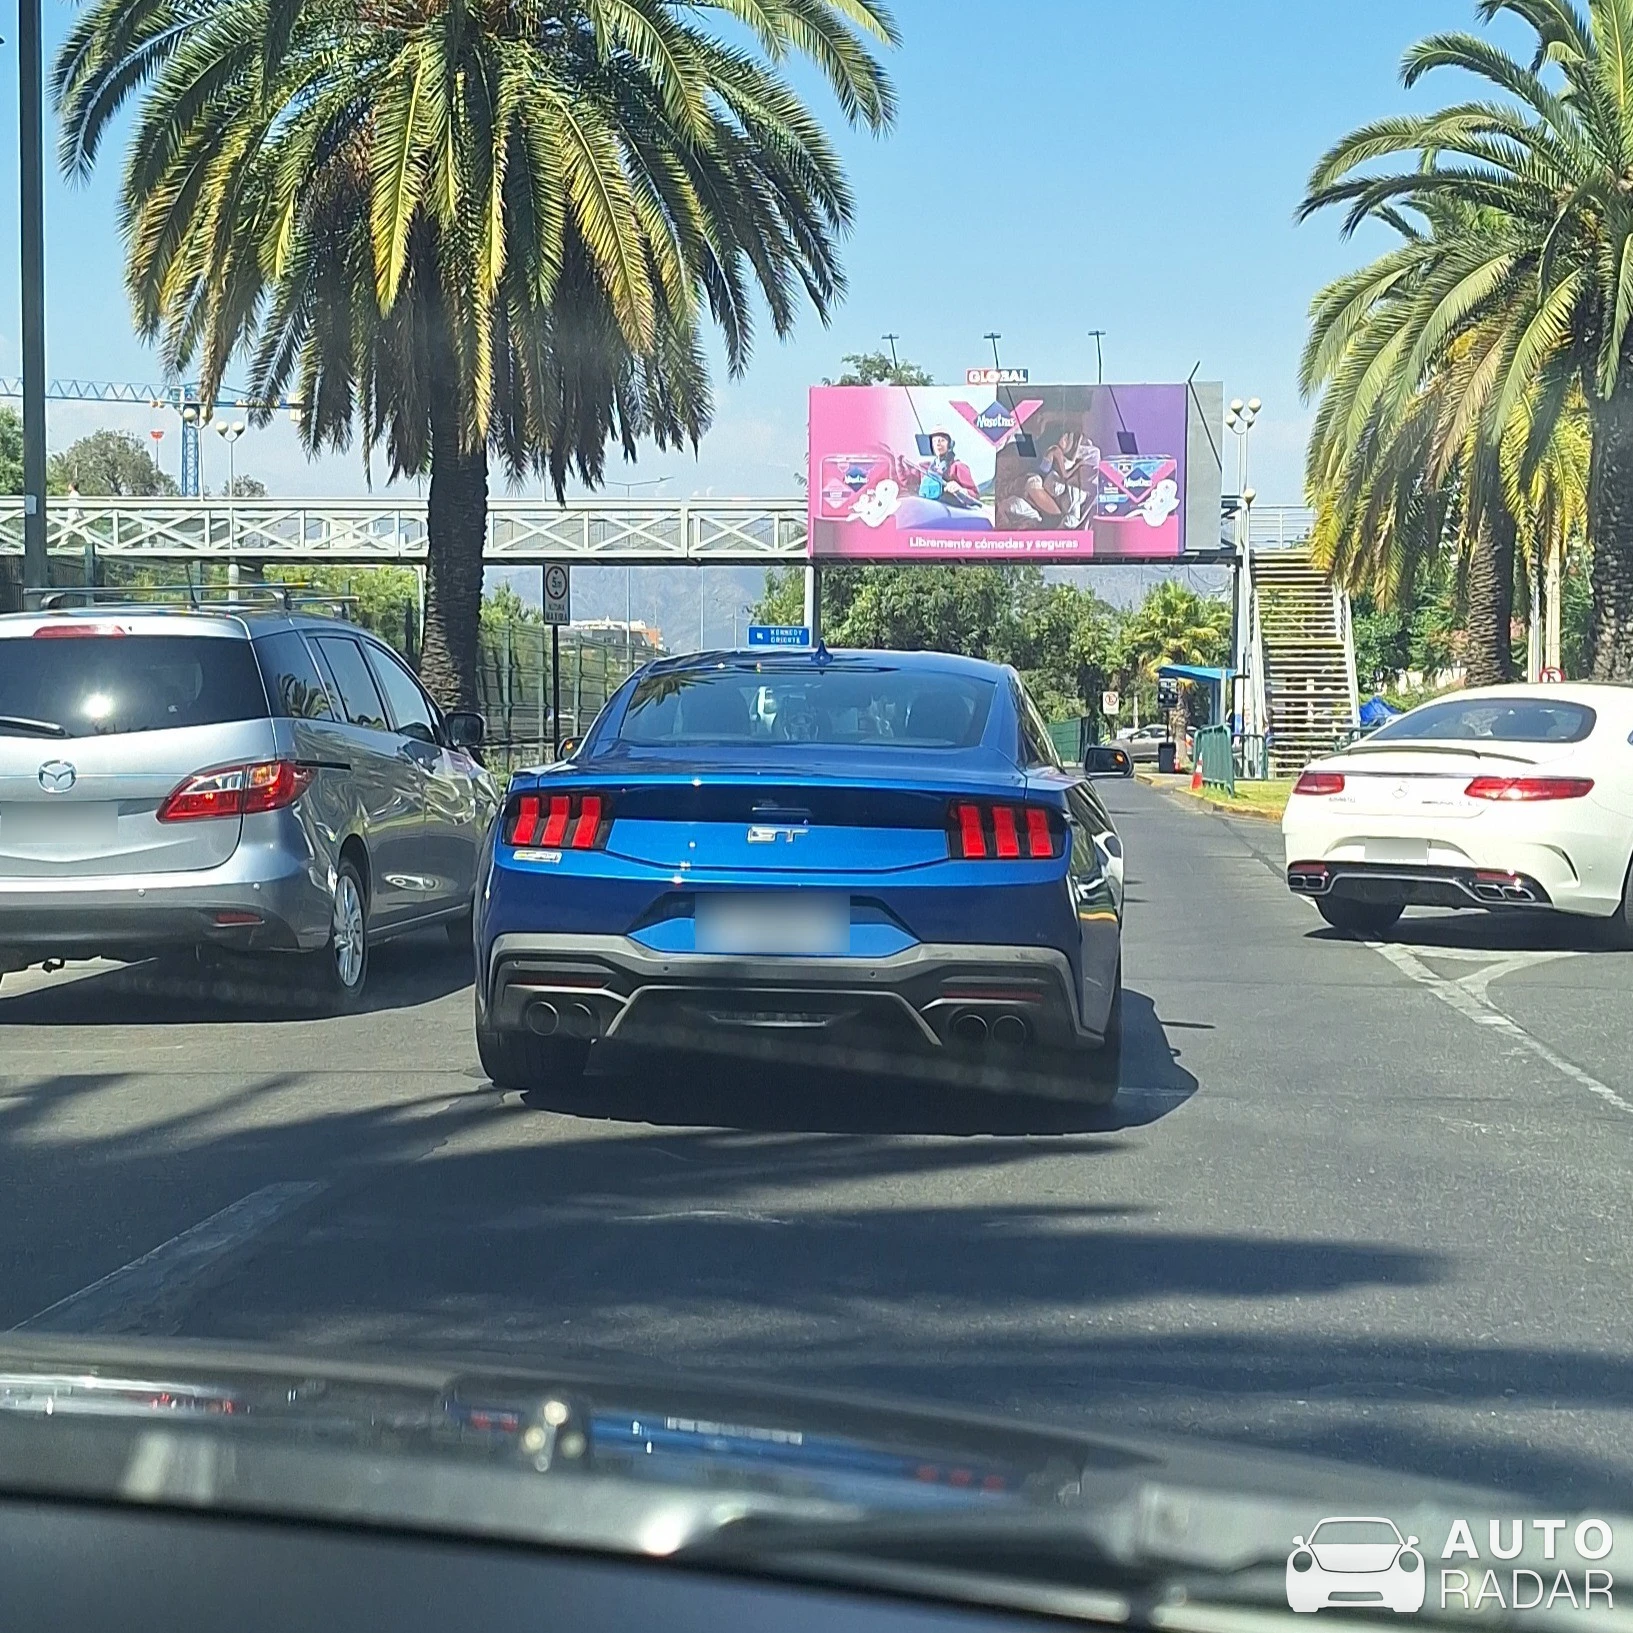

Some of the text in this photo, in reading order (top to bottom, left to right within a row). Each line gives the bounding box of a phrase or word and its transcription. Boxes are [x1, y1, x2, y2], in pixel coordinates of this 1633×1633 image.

[968, 370, 1027, 383] GLOBAL
[909, 537, 1079, 551] Libremente cómodas y seguras
[747, 826, 810, 843] GT
